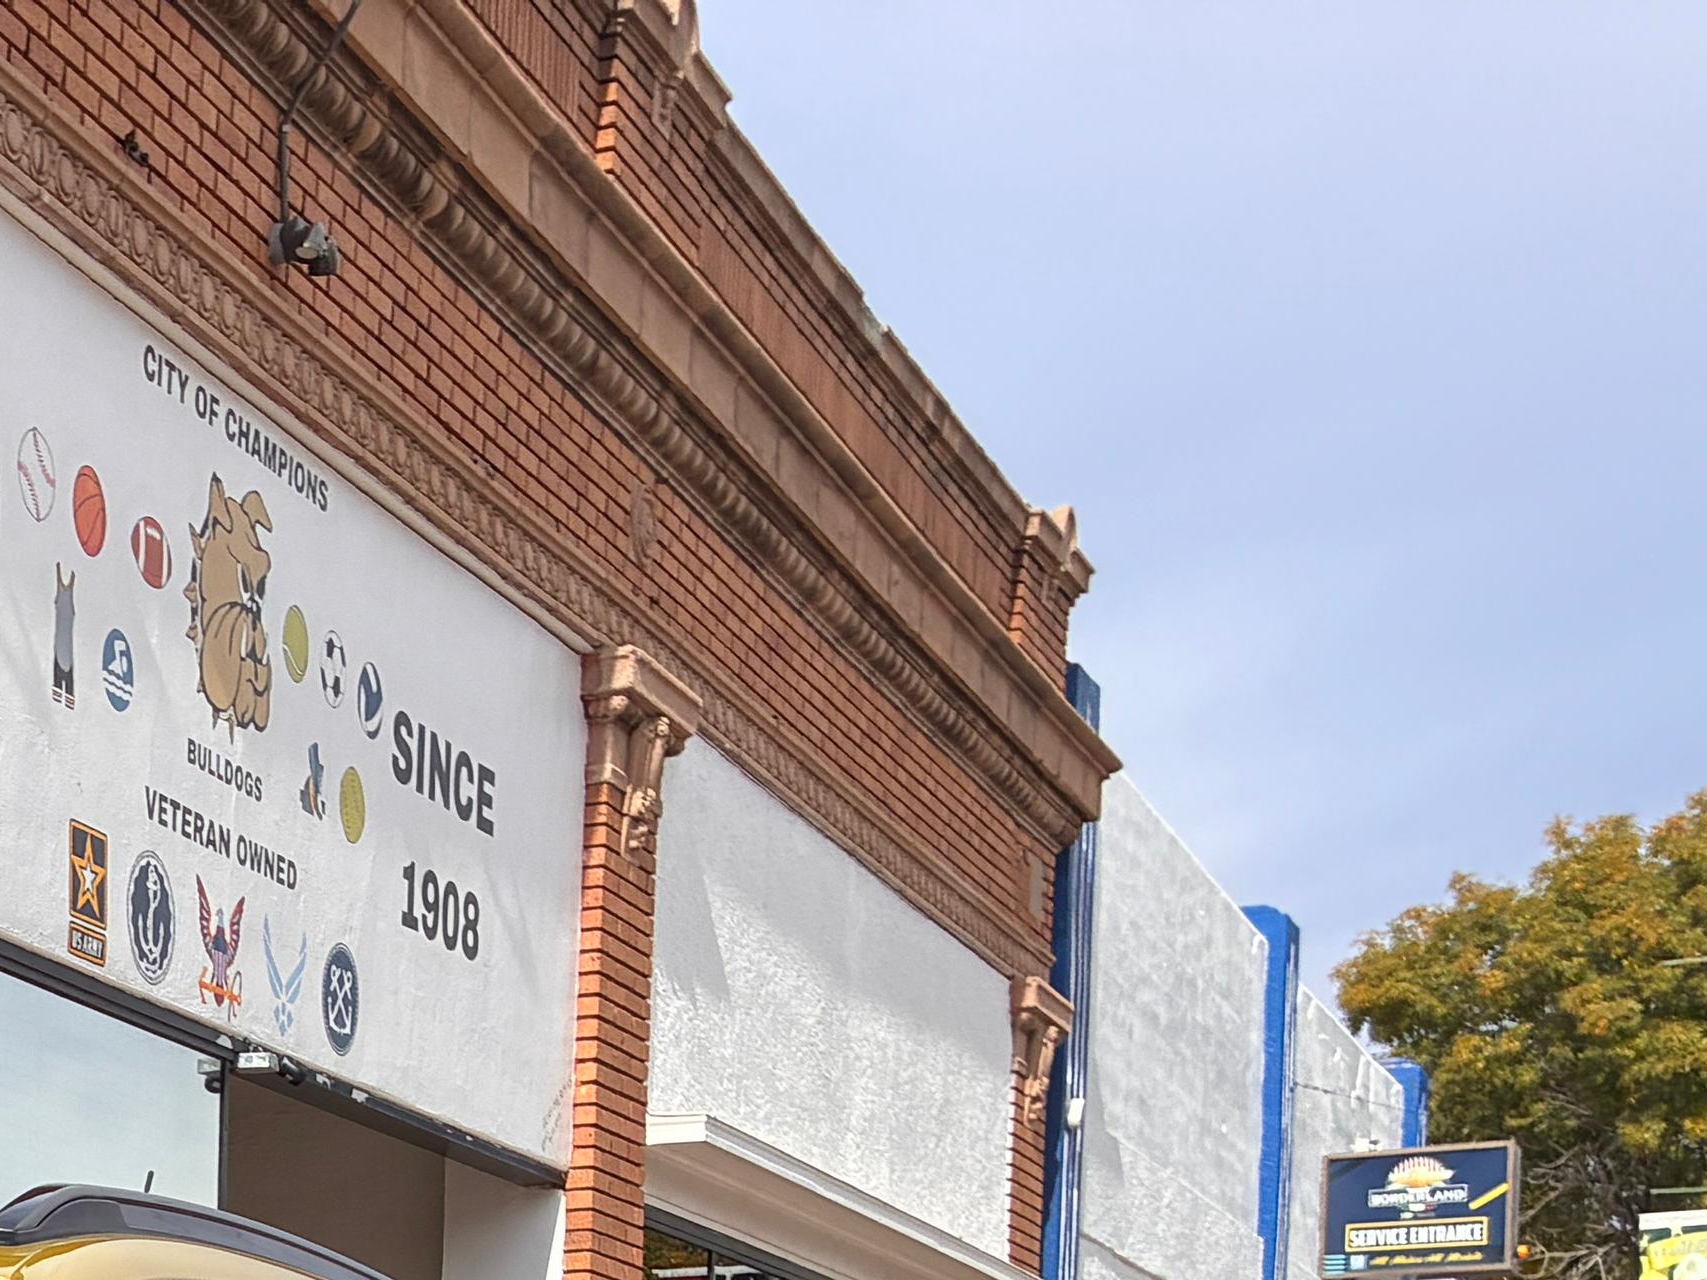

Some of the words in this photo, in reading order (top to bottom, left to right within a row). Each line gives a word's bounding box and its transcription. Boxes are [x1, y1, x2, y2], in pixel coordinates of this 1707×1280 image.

[143, 344, 188, 404] CITY
[195, 386, 221, 427] OF
[224, 408, 329, 512] CHAMPIONS
[187, 737, 263, 802] BULLDOGS
[391, 710, 495, 837] SINCE
[144, 785, 231, 859] VETERAN
[237, 834, 298, 890] OWNED
[401, 860, 481, 961] 1908
[1350, 1227, 1409, 1248] SERVICE
[1409, 1223, 1484, 1245] ENTRANCE
